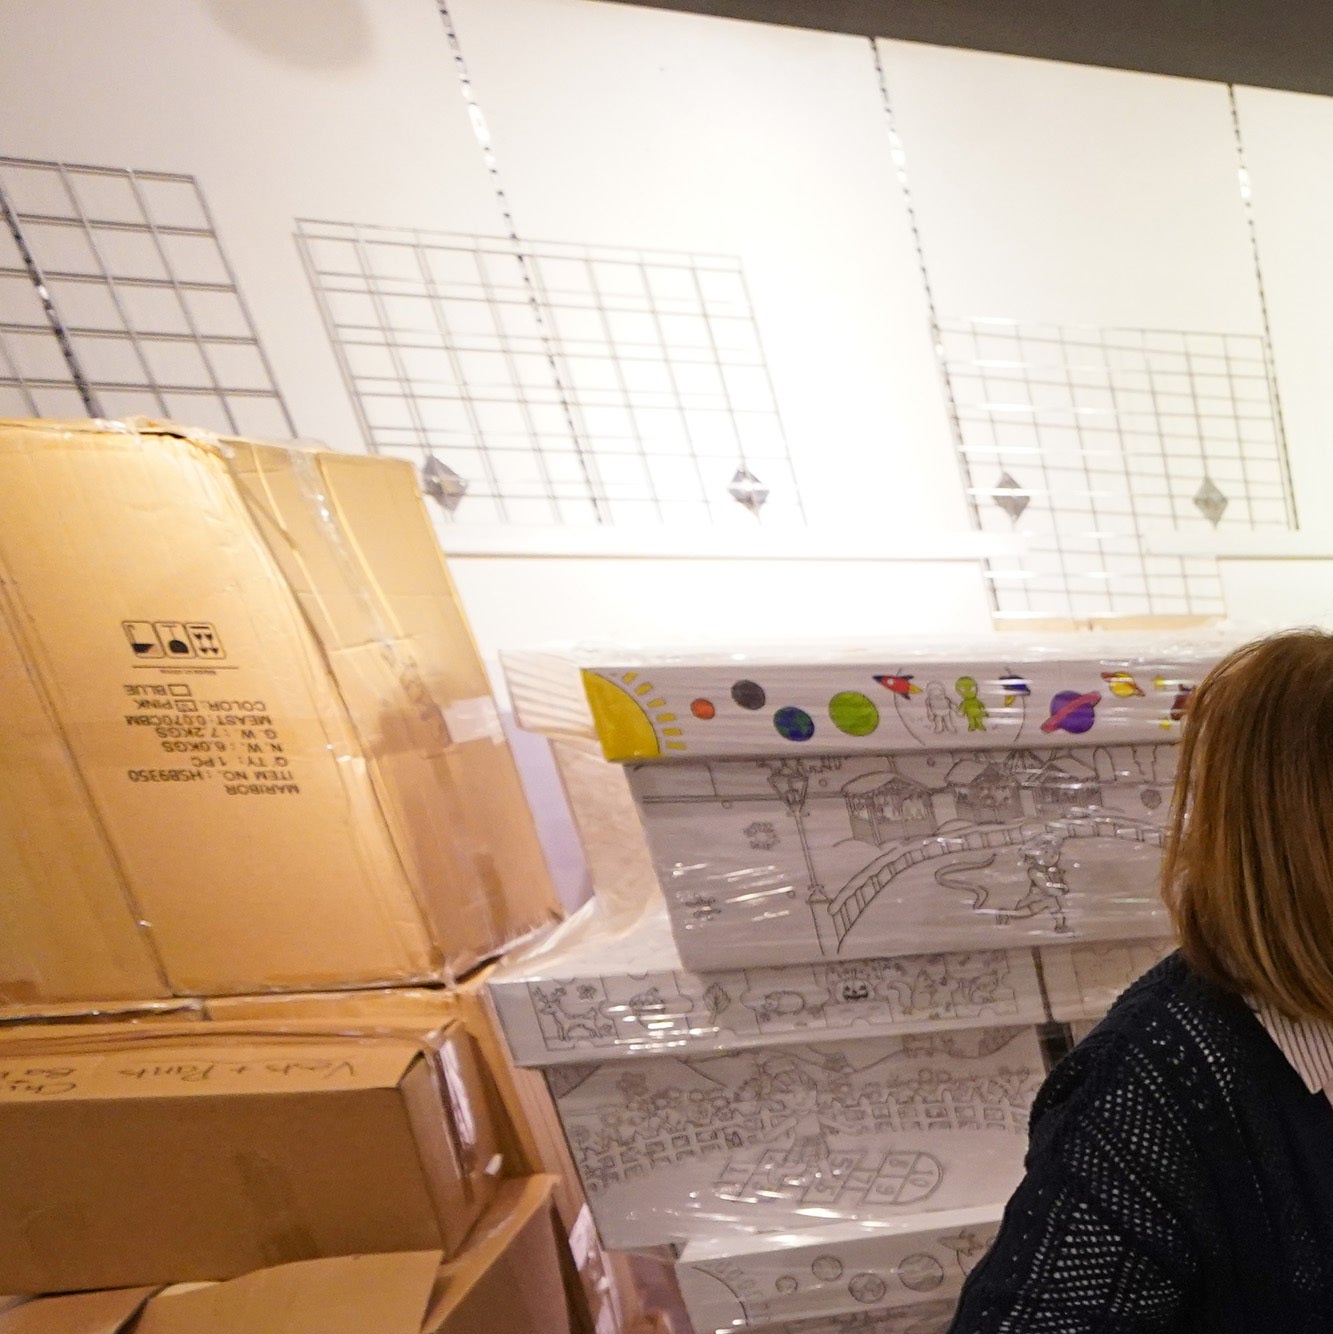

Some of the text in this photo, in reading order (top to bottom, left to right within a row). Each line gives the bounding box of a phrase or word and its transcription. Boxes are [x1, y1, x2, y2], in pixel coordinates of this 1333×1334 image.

[123, 684, 167, 696] BLUE
[255, 770, 294, 781] ITEM
[224, 784, 300, 796] MARIBOR
